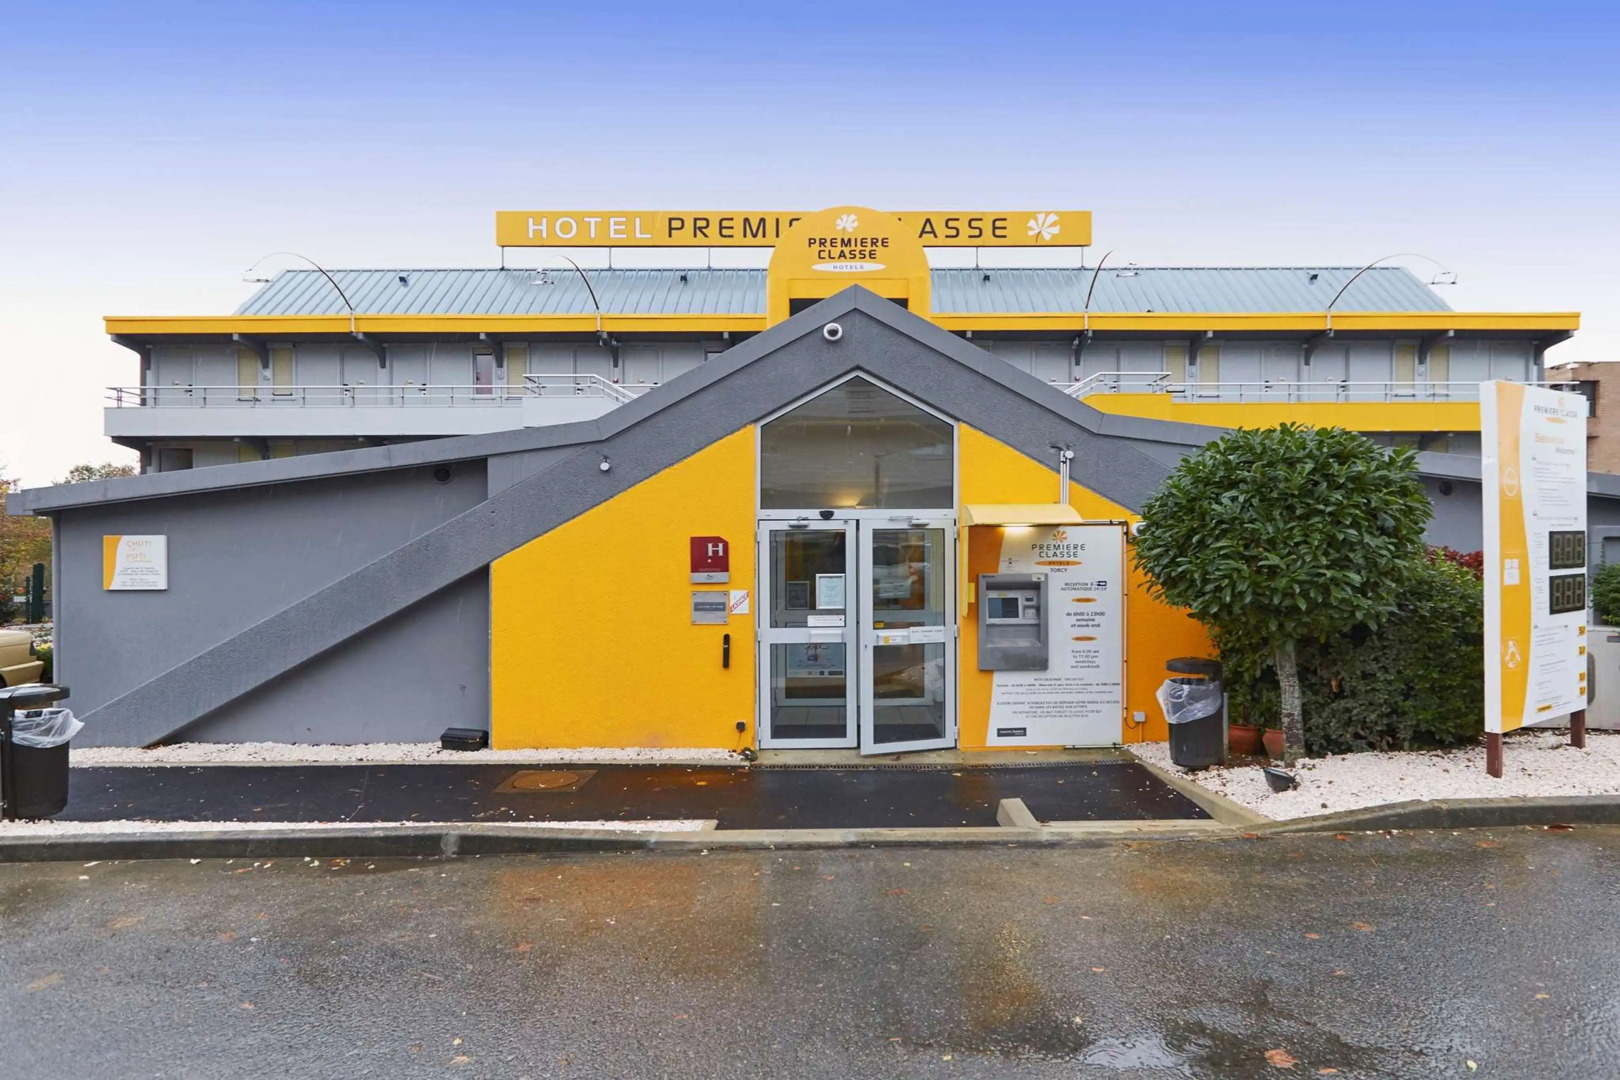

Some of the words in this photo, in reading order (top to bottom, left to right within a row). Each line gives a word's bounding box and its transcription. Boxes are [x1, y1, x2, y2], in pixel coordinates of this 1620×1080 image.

[527, 216, 652, 240] HOTEL
[666, 216, 803, 240] PREMI
[916, 217, 1009, 239] ASSE
[807, 237, 890, 248] PREMIERE
[817, 249, 878, 260] CLASSE
[706, 542, 725, 557] H
[1031, 543, 1086, 551] PREMIERE
